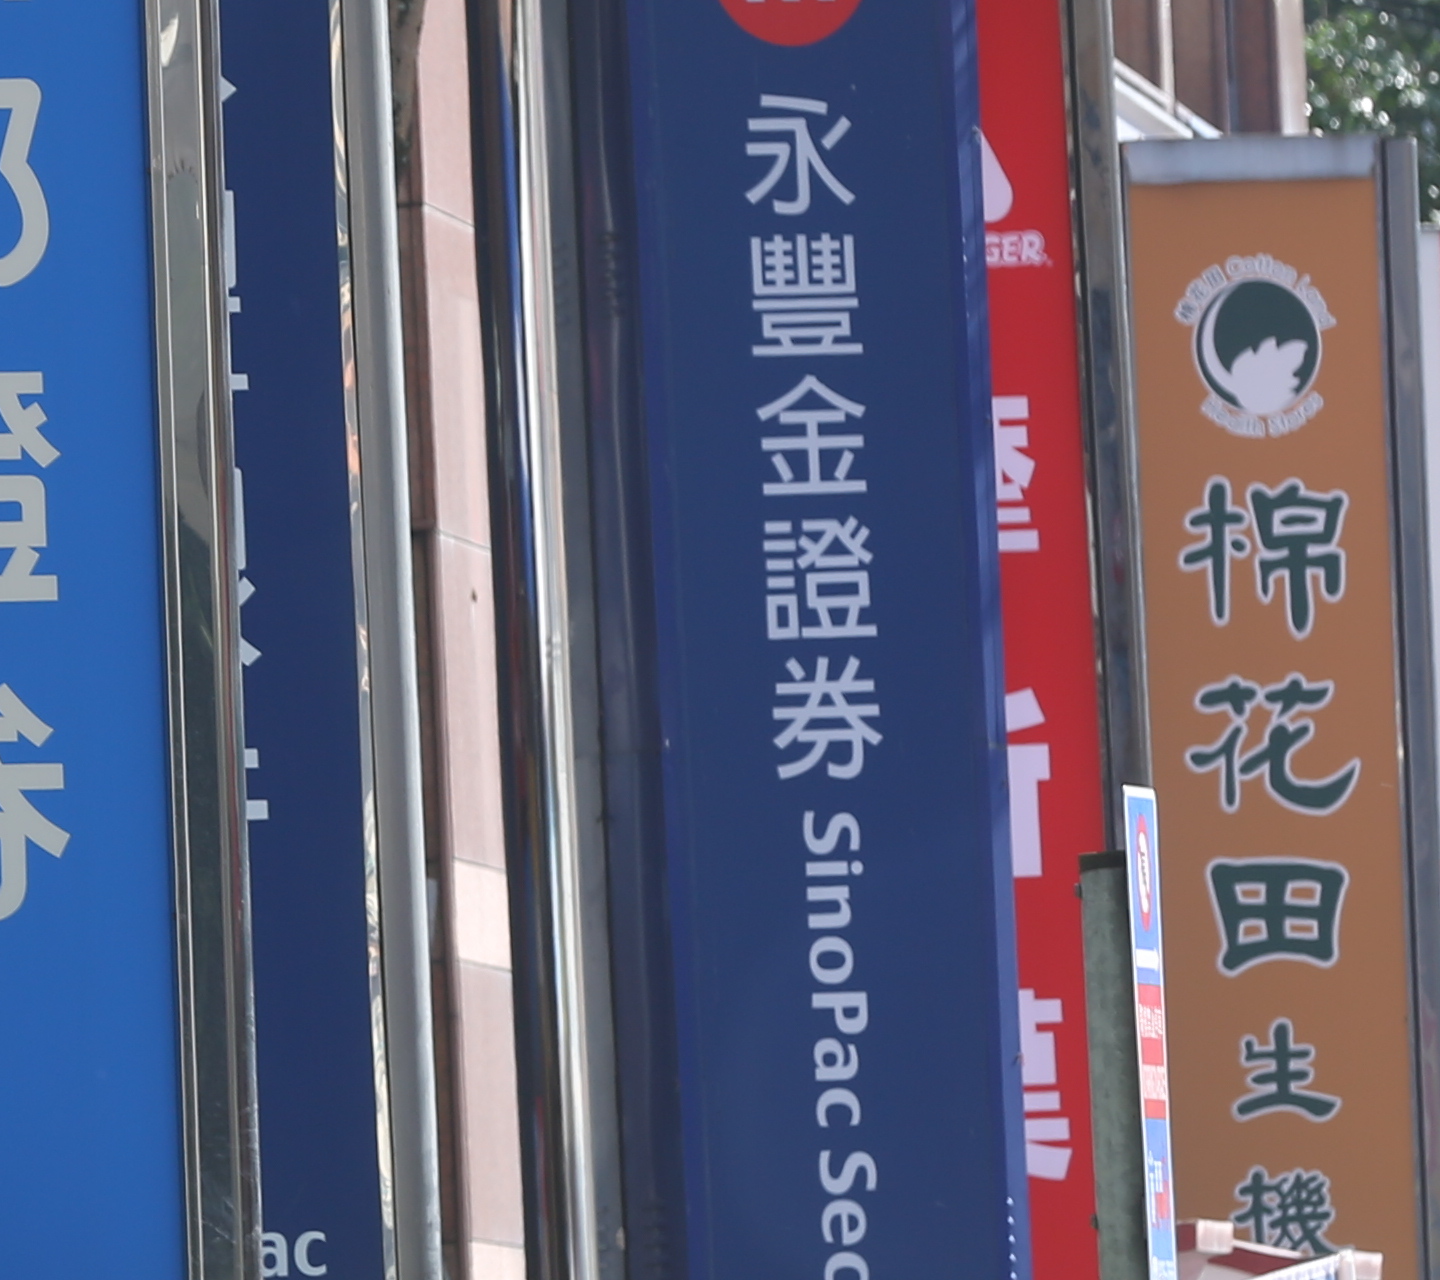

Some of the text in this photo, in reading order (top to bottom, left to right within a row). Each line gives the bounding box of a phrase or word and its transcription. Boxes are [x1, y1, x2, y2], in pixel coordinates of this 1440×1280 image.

[745, 93, 883, 781] 永豐金證券
[985, 228, 1052, 267] GER
[803, 810, 869, 1127] SinoPac
[1178, 474, 1361, 1257] 棉花田生機
